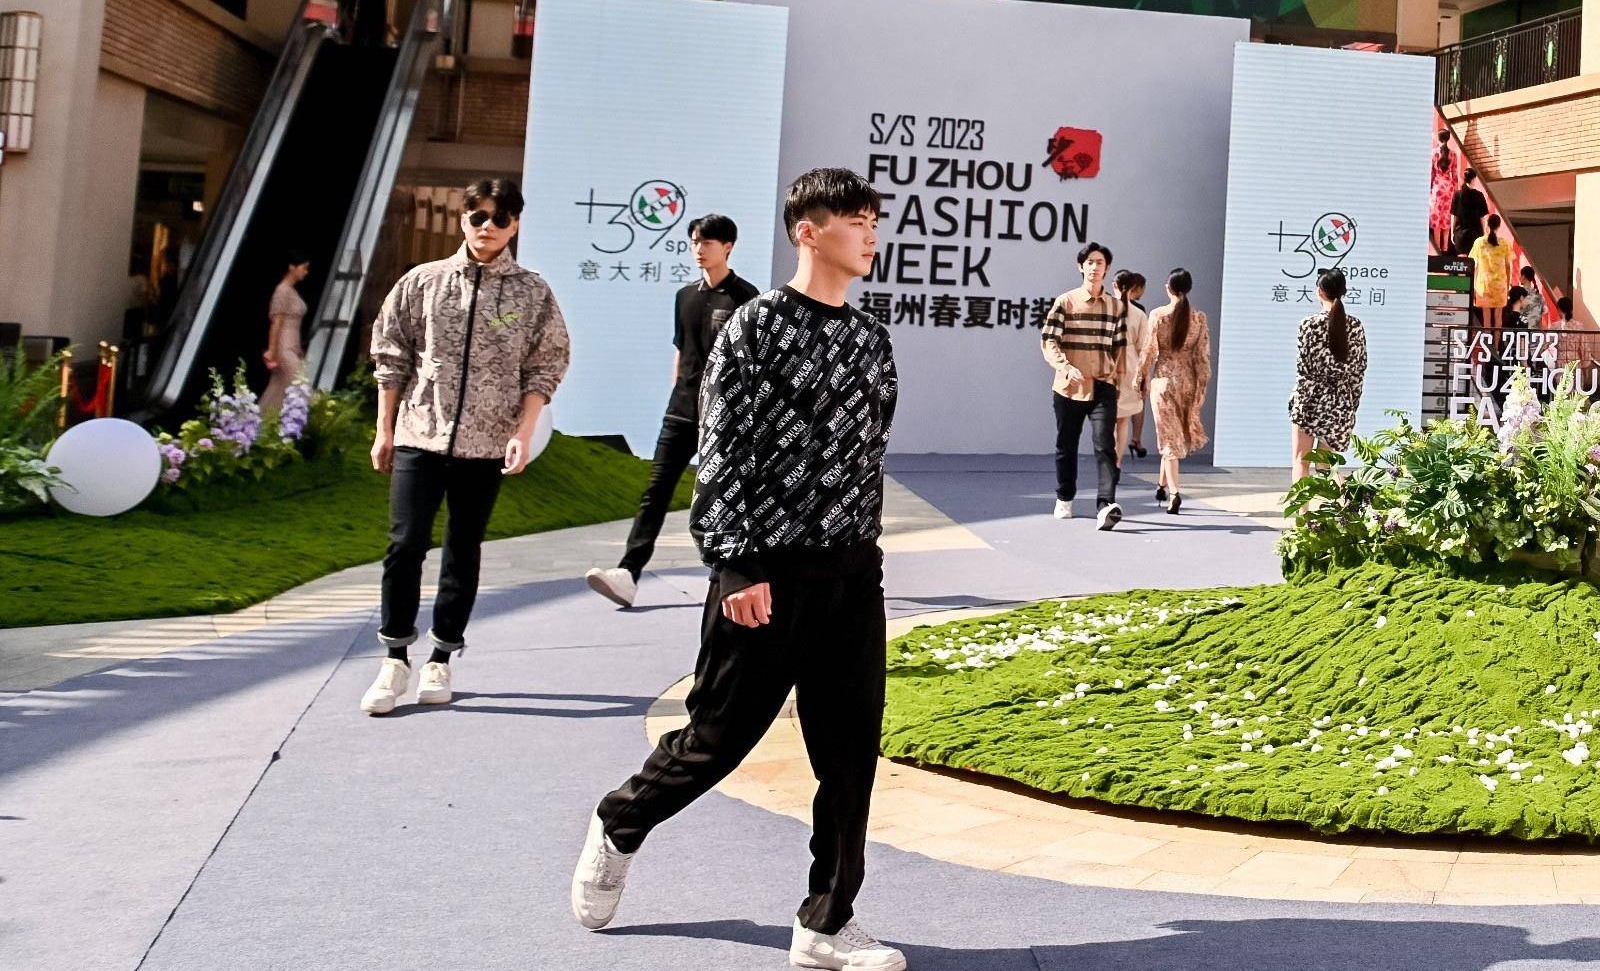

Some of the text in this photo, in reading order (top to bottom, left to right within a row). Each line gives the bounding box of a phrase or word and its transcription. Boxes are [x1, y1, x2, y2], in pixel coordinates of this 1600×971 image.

[869, 112, 985, 151] S/S 2023
[868, 153, 917, 186] FU
[925, 156, 1033, 193] ZHOU
[1342, 266, 1389, 280] space
[1271, 283, 1386, 306] 意大空间
[1453, 329, 1559, 364] S/S 2023
